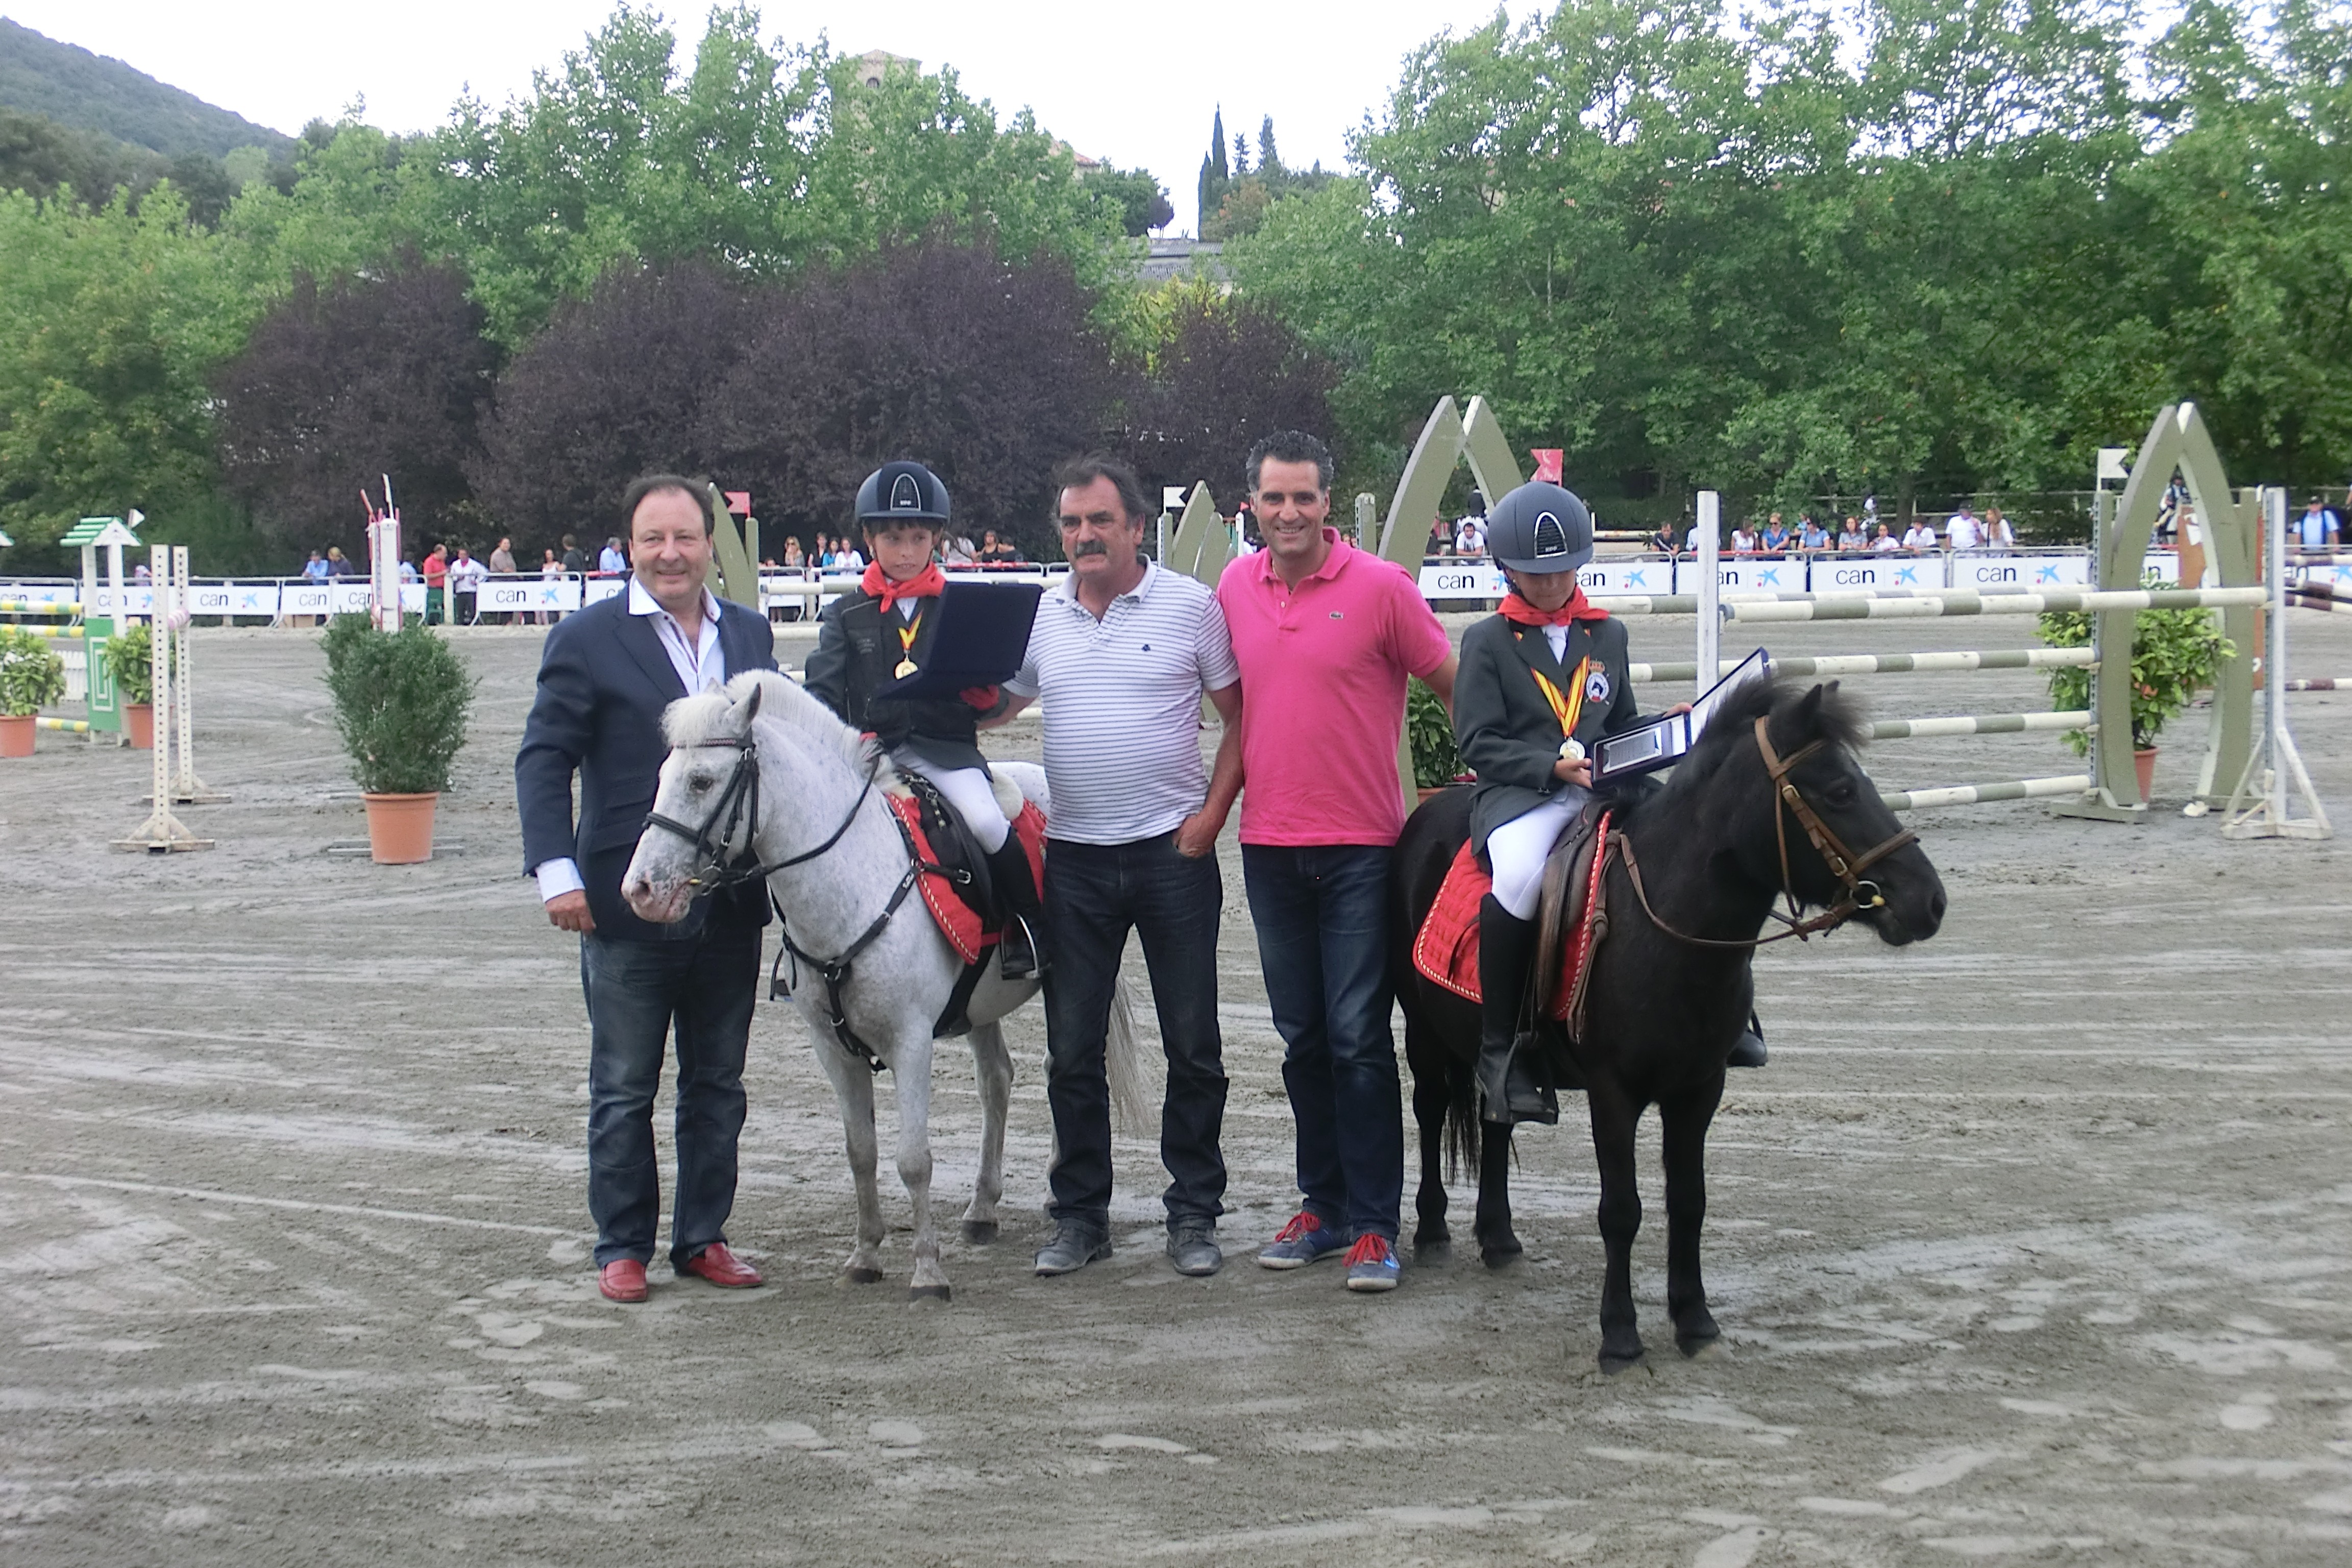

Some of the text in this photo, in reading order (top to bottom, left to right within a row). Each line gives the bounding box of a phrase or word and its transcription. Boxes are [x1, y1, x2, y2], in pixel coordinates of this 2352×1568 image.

[1836, 570, 1875, 584] can
[1976, 567, 2016, 582] can
[1437, 575, 1475, 590] can
[200, 594, 228, 606] can
[298, 594, 327, 606] can
[496, 589, 526, 603] can
